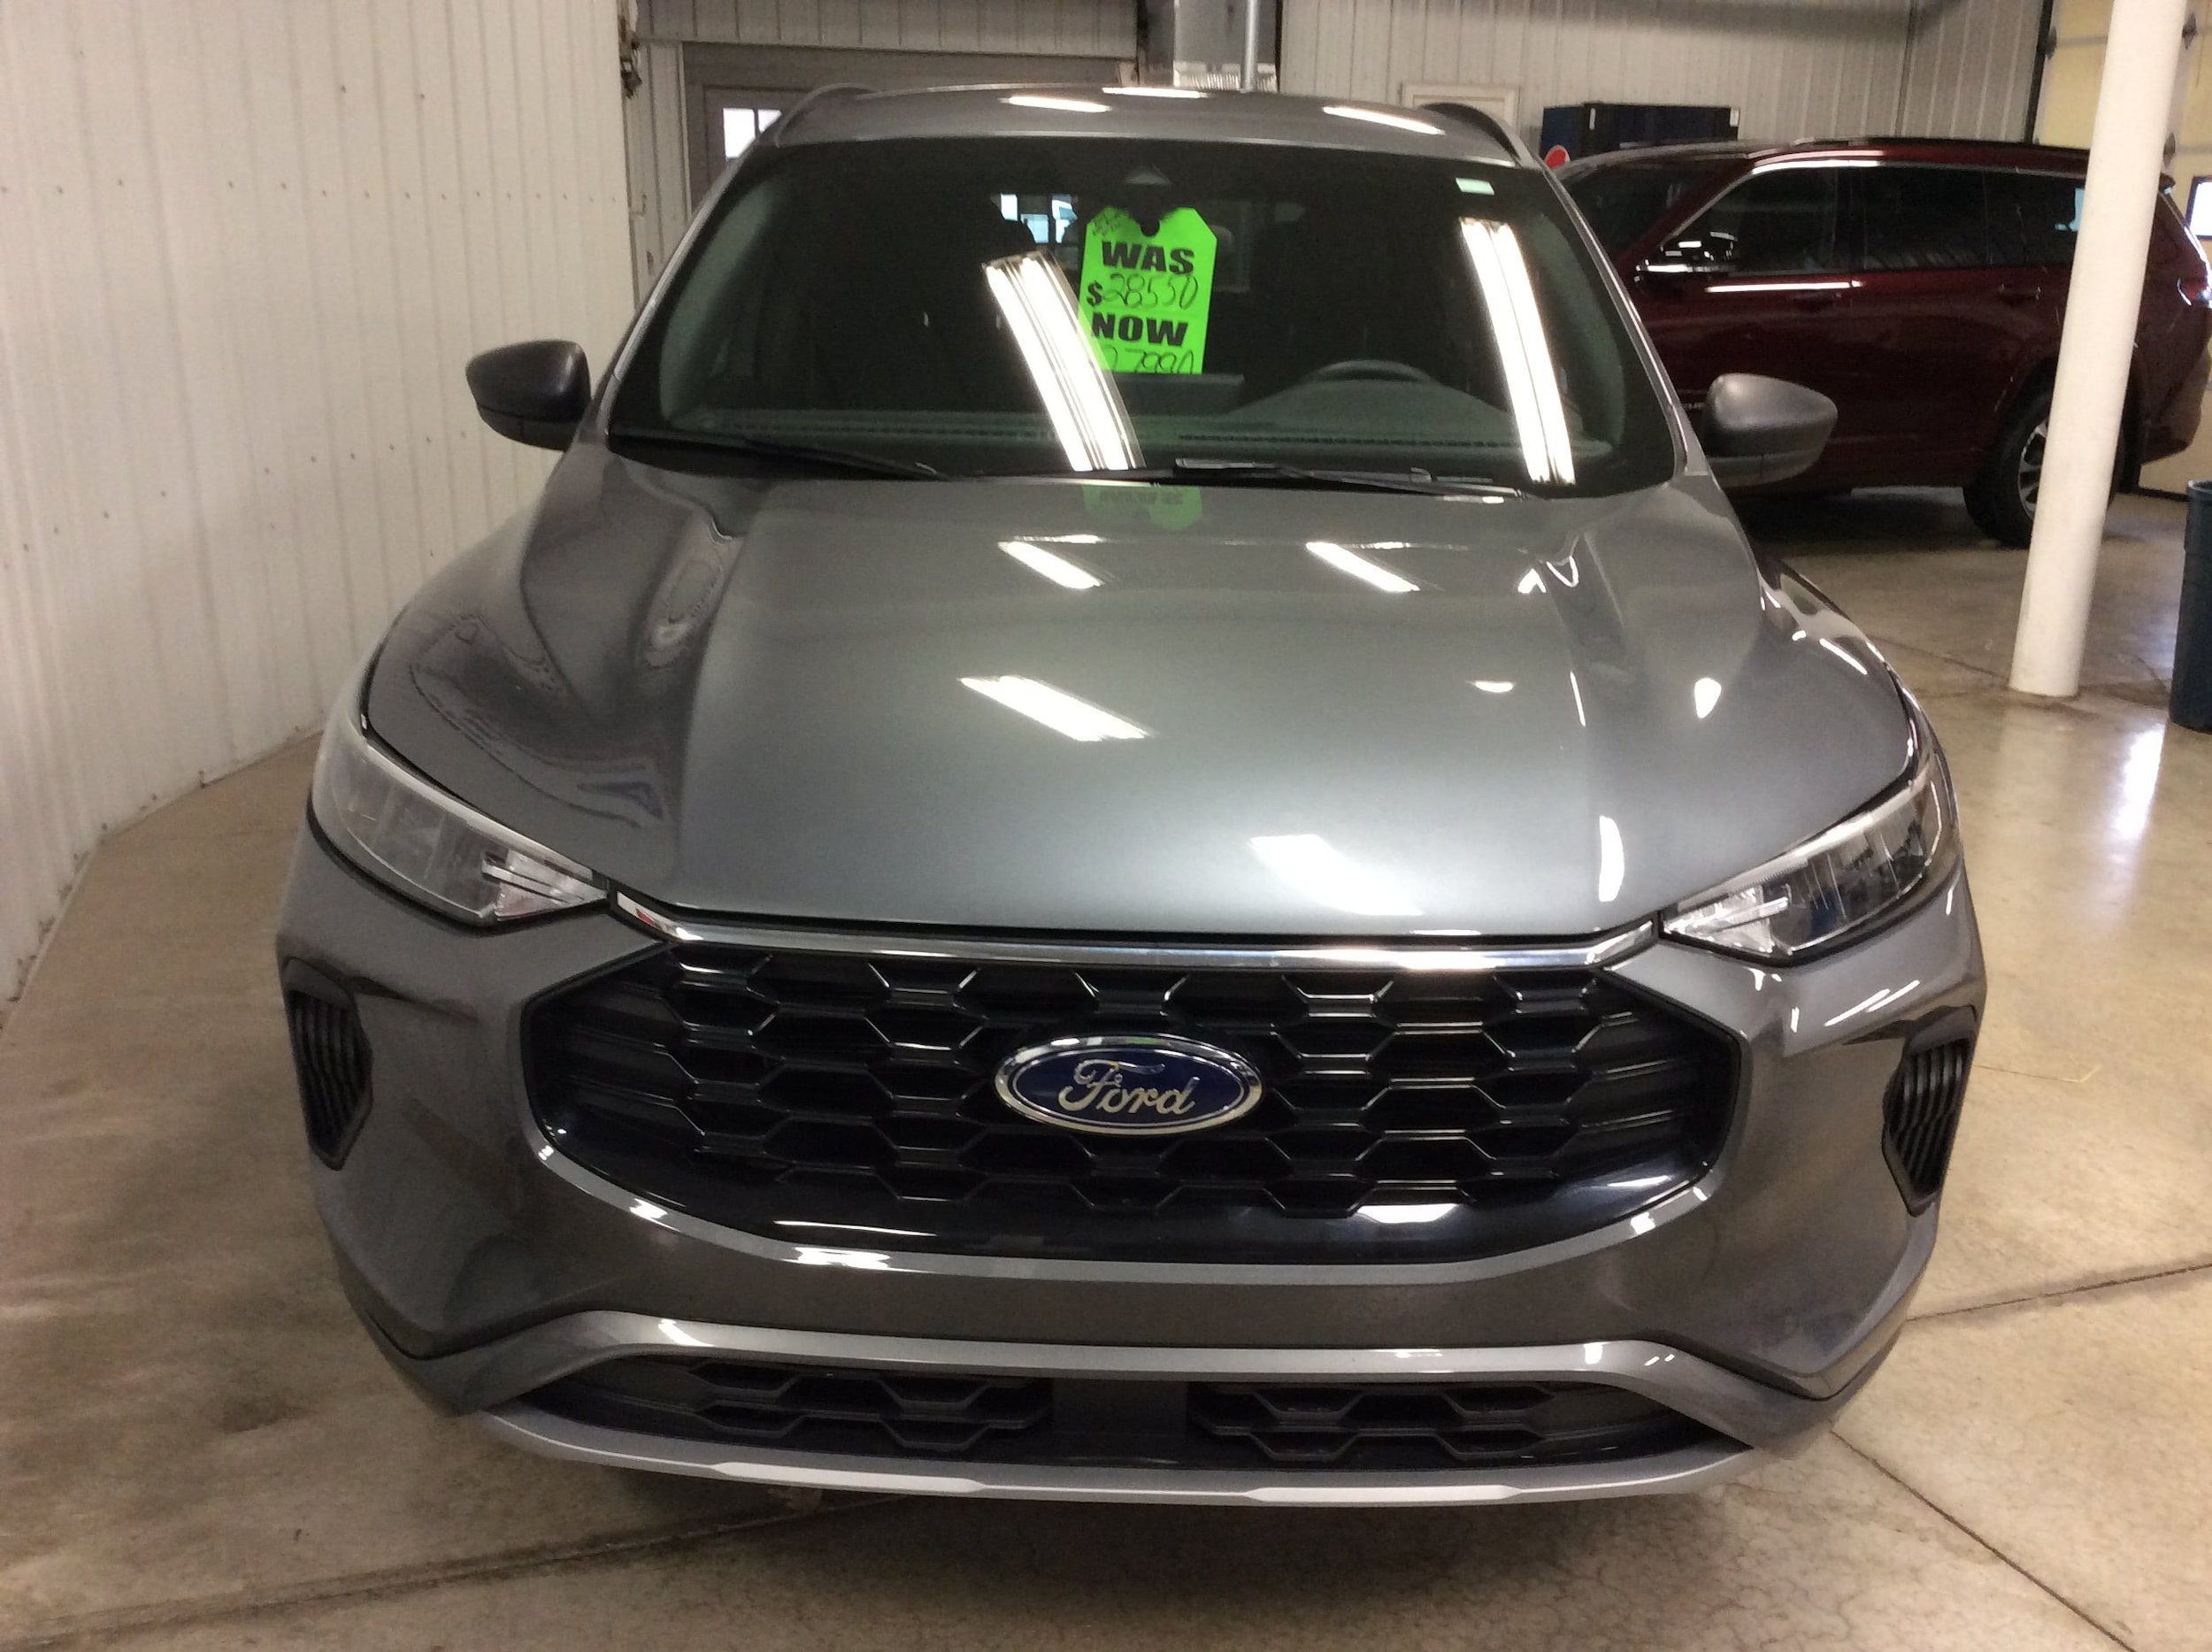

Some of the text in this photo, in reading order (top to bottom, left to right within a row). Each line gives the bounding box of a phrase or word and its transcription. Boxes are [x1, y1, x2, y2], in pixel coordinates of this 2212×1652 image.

[1102, 241, 1194, 274] WAS
[1092, 312, 1188, 346] NOW
[1058, 1059, 1200, 1115] Ford
